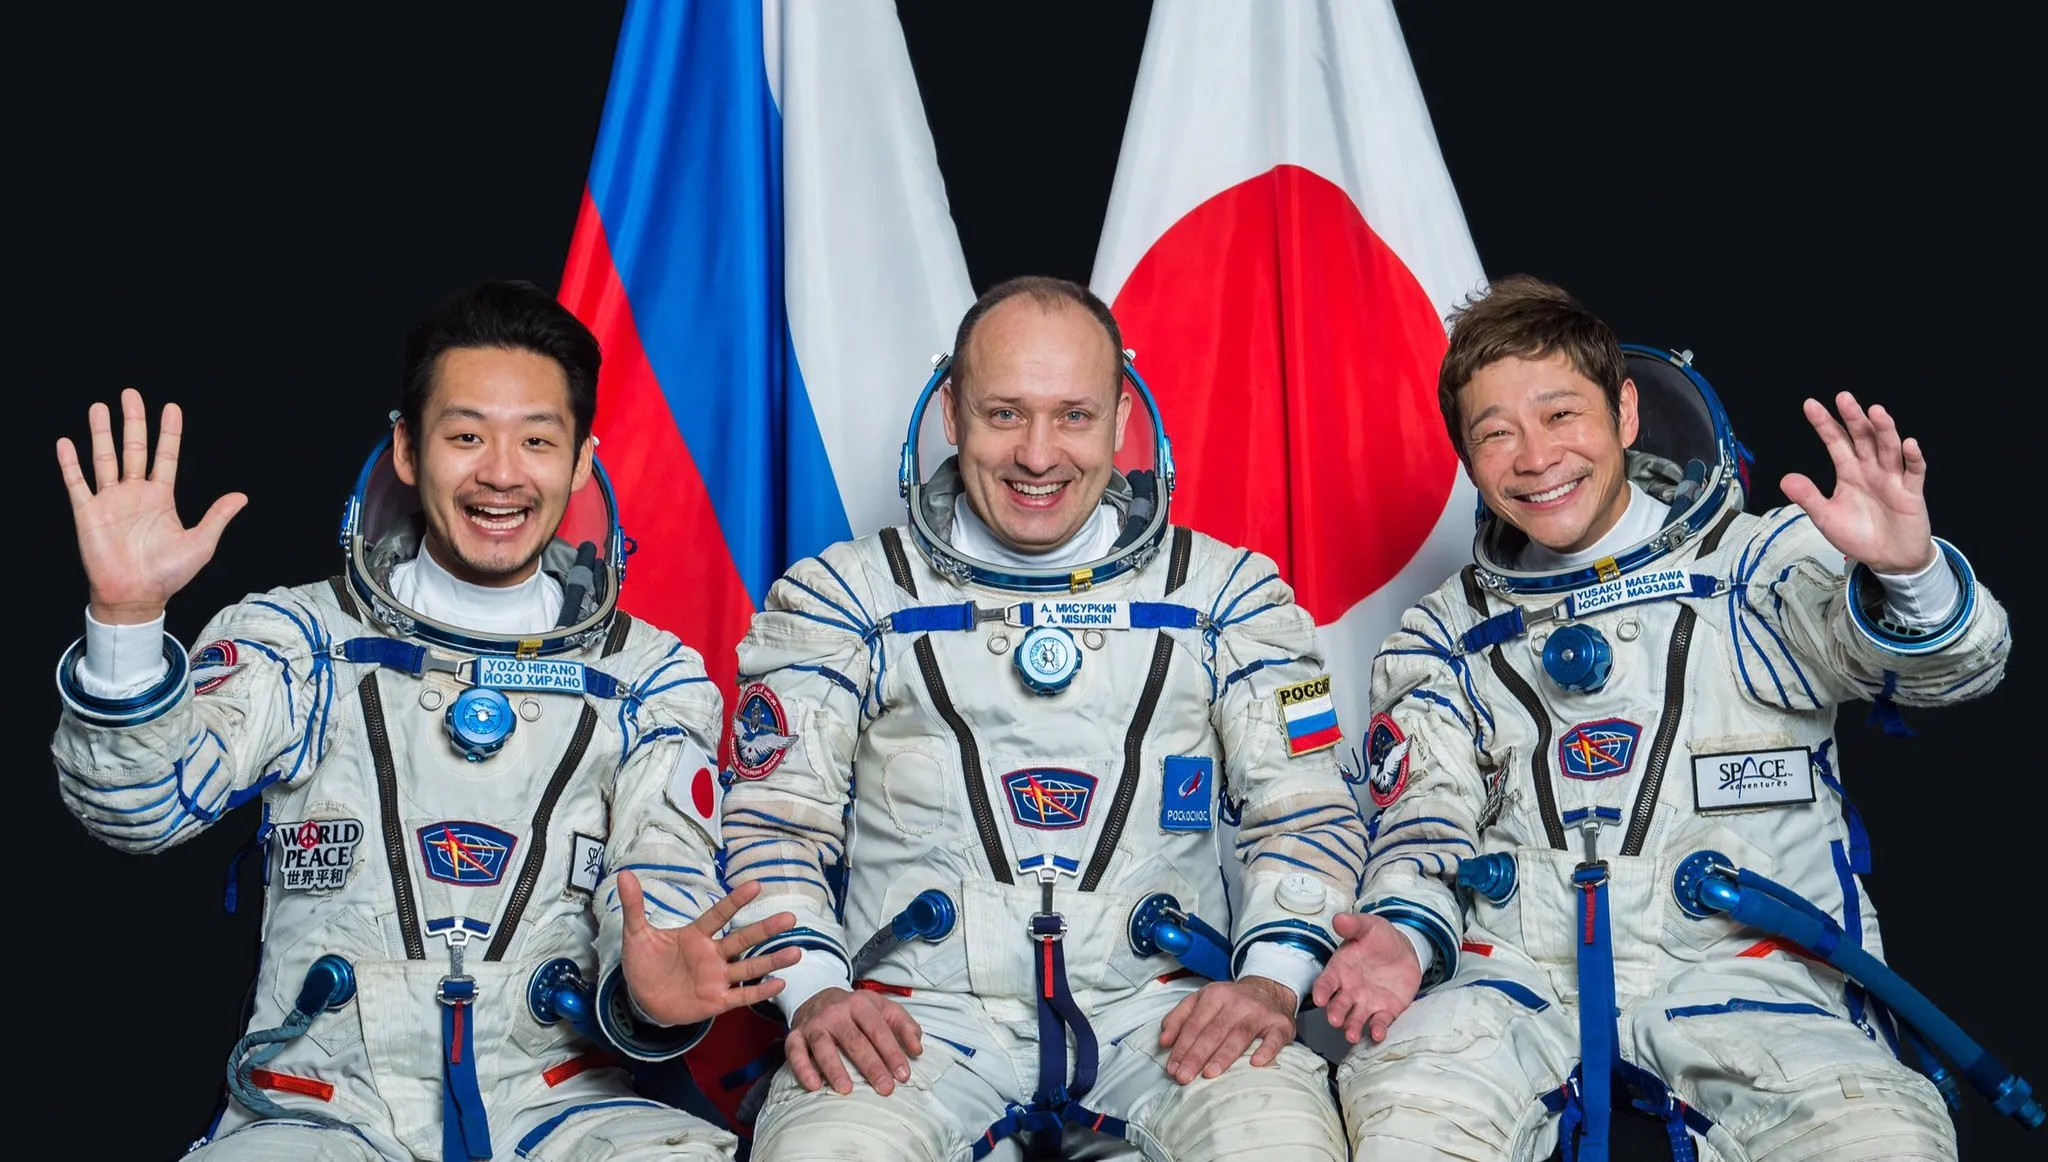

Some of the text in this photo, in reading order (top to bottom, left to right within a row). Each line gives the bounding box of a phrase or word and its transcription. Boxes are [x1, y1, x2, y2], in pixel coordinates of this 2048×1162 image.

[1577, 570, 1684, 600] YUSAKU MAEZAWA
[1579, 581, 1685, 610] ЮСАКУ МАЭЗАВА
[1056, 603, 1117, 613] МИСУРКИН
[1061, 614, 1112, 624] MISURKIN
[488, 660, 577, 676] YOZO HIRANO
[484, 671, 580, 688] ЙОЗО ХИРАНО
[1718, 757, 1787, 790] SPACE
[1729, 780, 1788, 791] adventures
[281, 822, 360, 849] WORLD
[285, 846, 350, 868] PEACE
[287, 868, 343, 886] 世界平和
